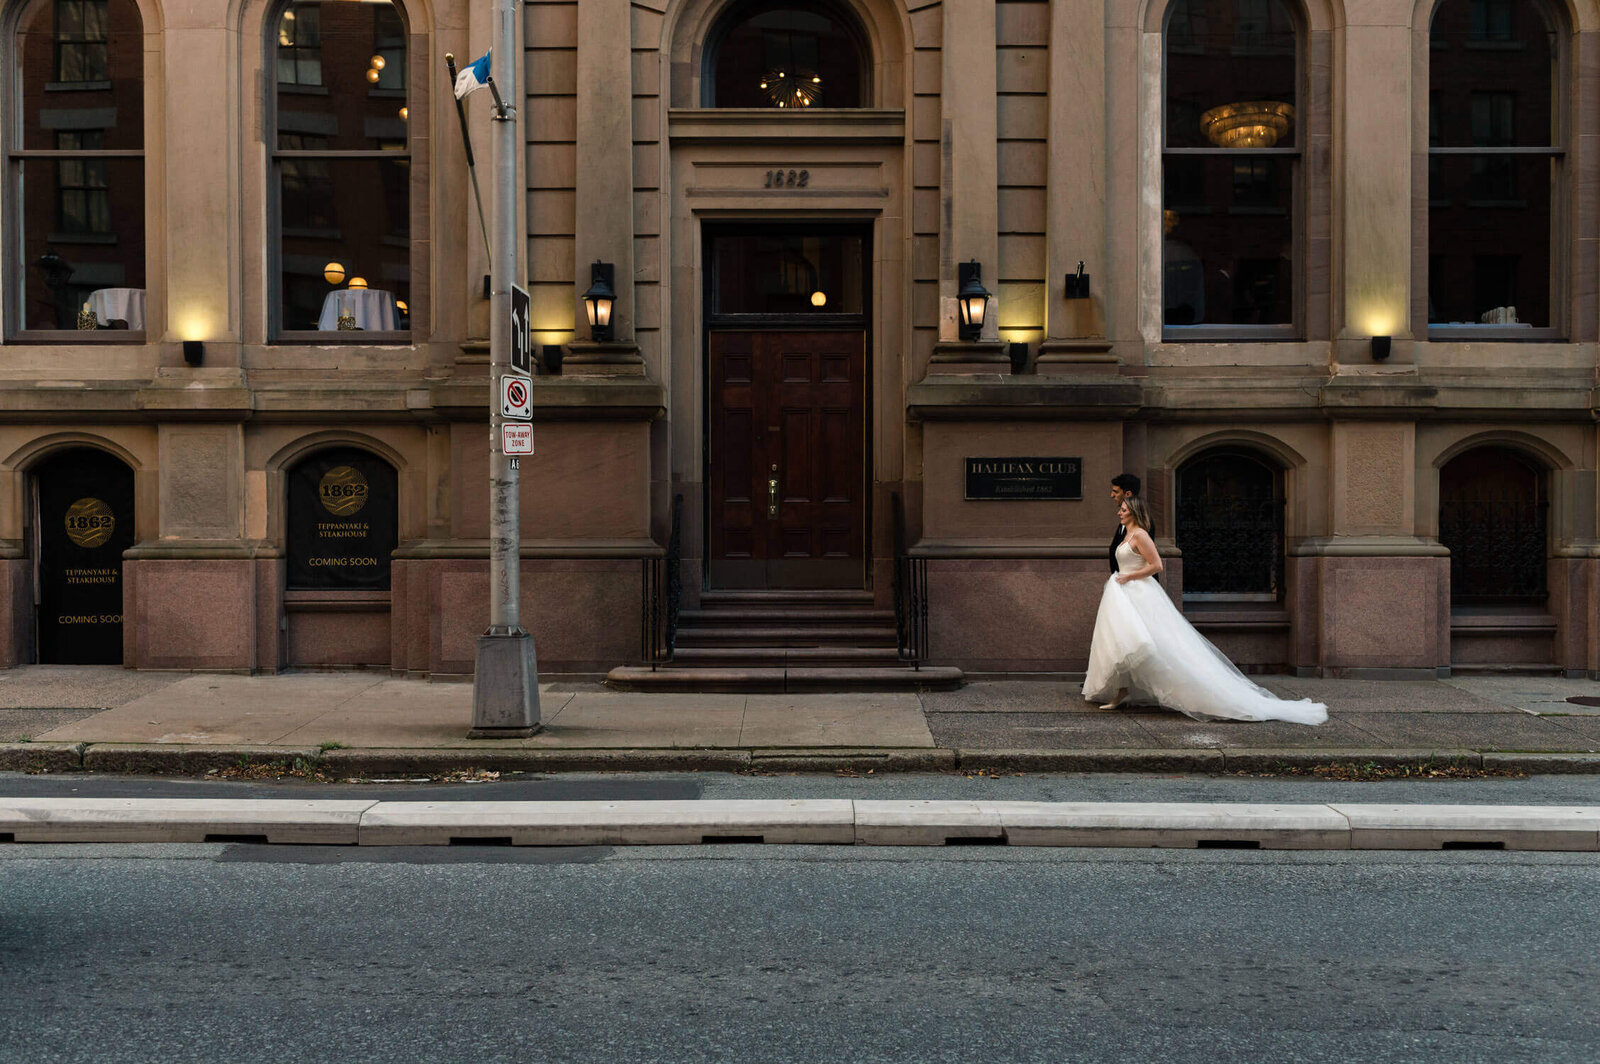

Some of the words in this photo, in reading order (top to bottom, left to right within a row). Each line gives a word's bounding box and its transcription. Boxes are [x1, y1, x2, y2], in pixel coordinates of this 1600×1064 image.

[764, 169, 809, 188] 1682
[971, 463, 1034, 474] HALIFAX
[1039, 463, 1077, 474] CLUB
[323, 485, 365, 497] 1862
[68, 515, 113, 529] 1862
[318, 522, 361, 530] TEPPANYAKI
[308, 557, 348, 566] COMING
[349, 557, 377, 566] SOON
[67, 576, 116, 584] STEAKHOUSE
[58, 615, 98, 624] COMING
